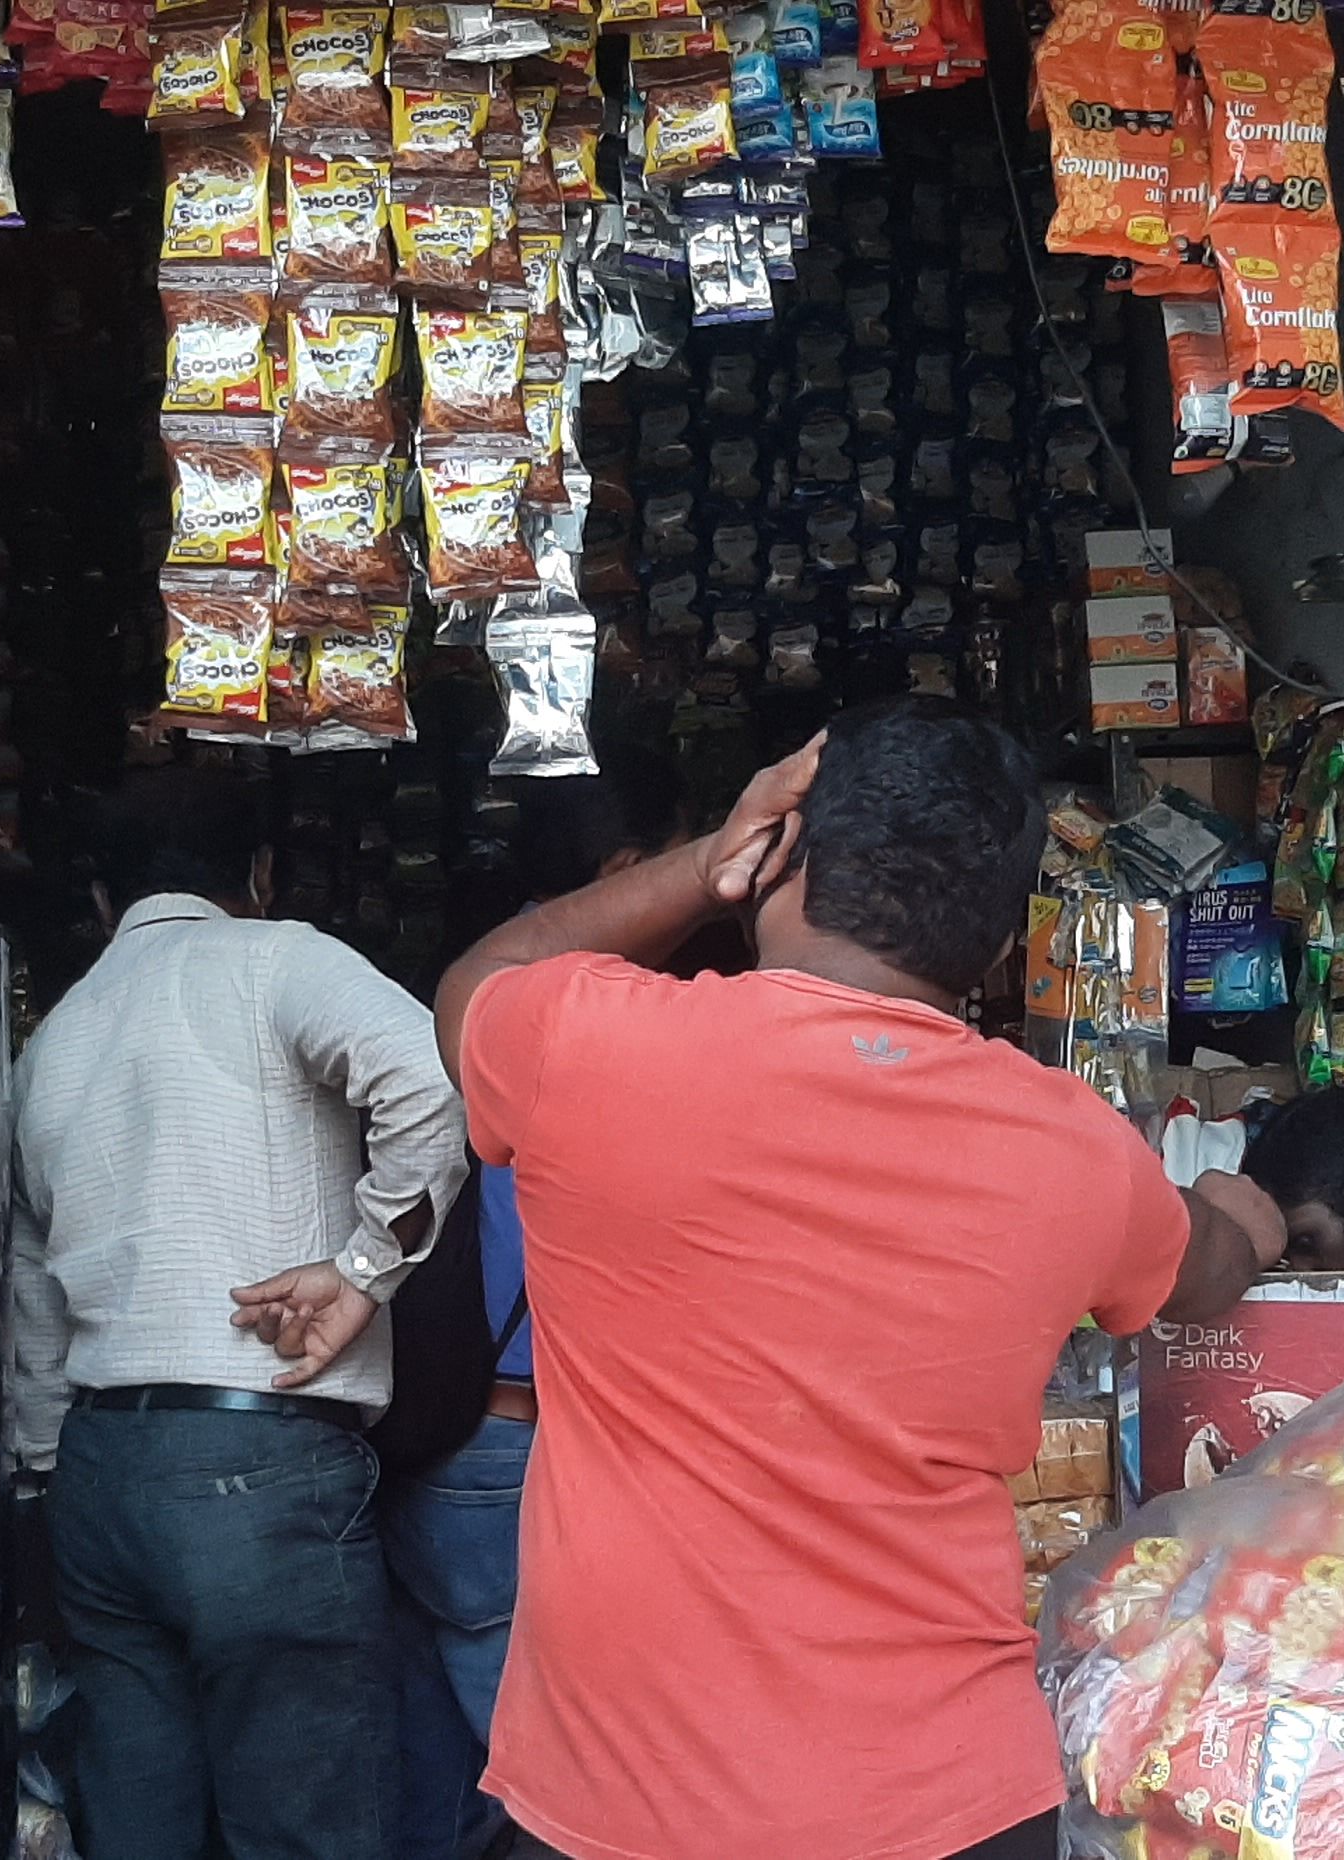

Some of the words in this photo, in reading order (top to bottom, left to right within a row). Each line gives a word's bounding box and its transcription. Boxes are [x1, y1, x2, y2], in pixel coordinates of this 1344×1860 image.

[291, 34, 367, 58] CHOCOS
[180, 351, 257, 378] CHOCOS
[295, 491, 370, 518] CHOCOS
[182, 506, 261, 531] CHOCOS
[1189, 907, 1223, 923] SHUT
[1228, 905, 1254, 921] OUT
[1185, 1323, 1245, 1347] Dark
[1166, 1347, 1265, 1373] Fantasy
